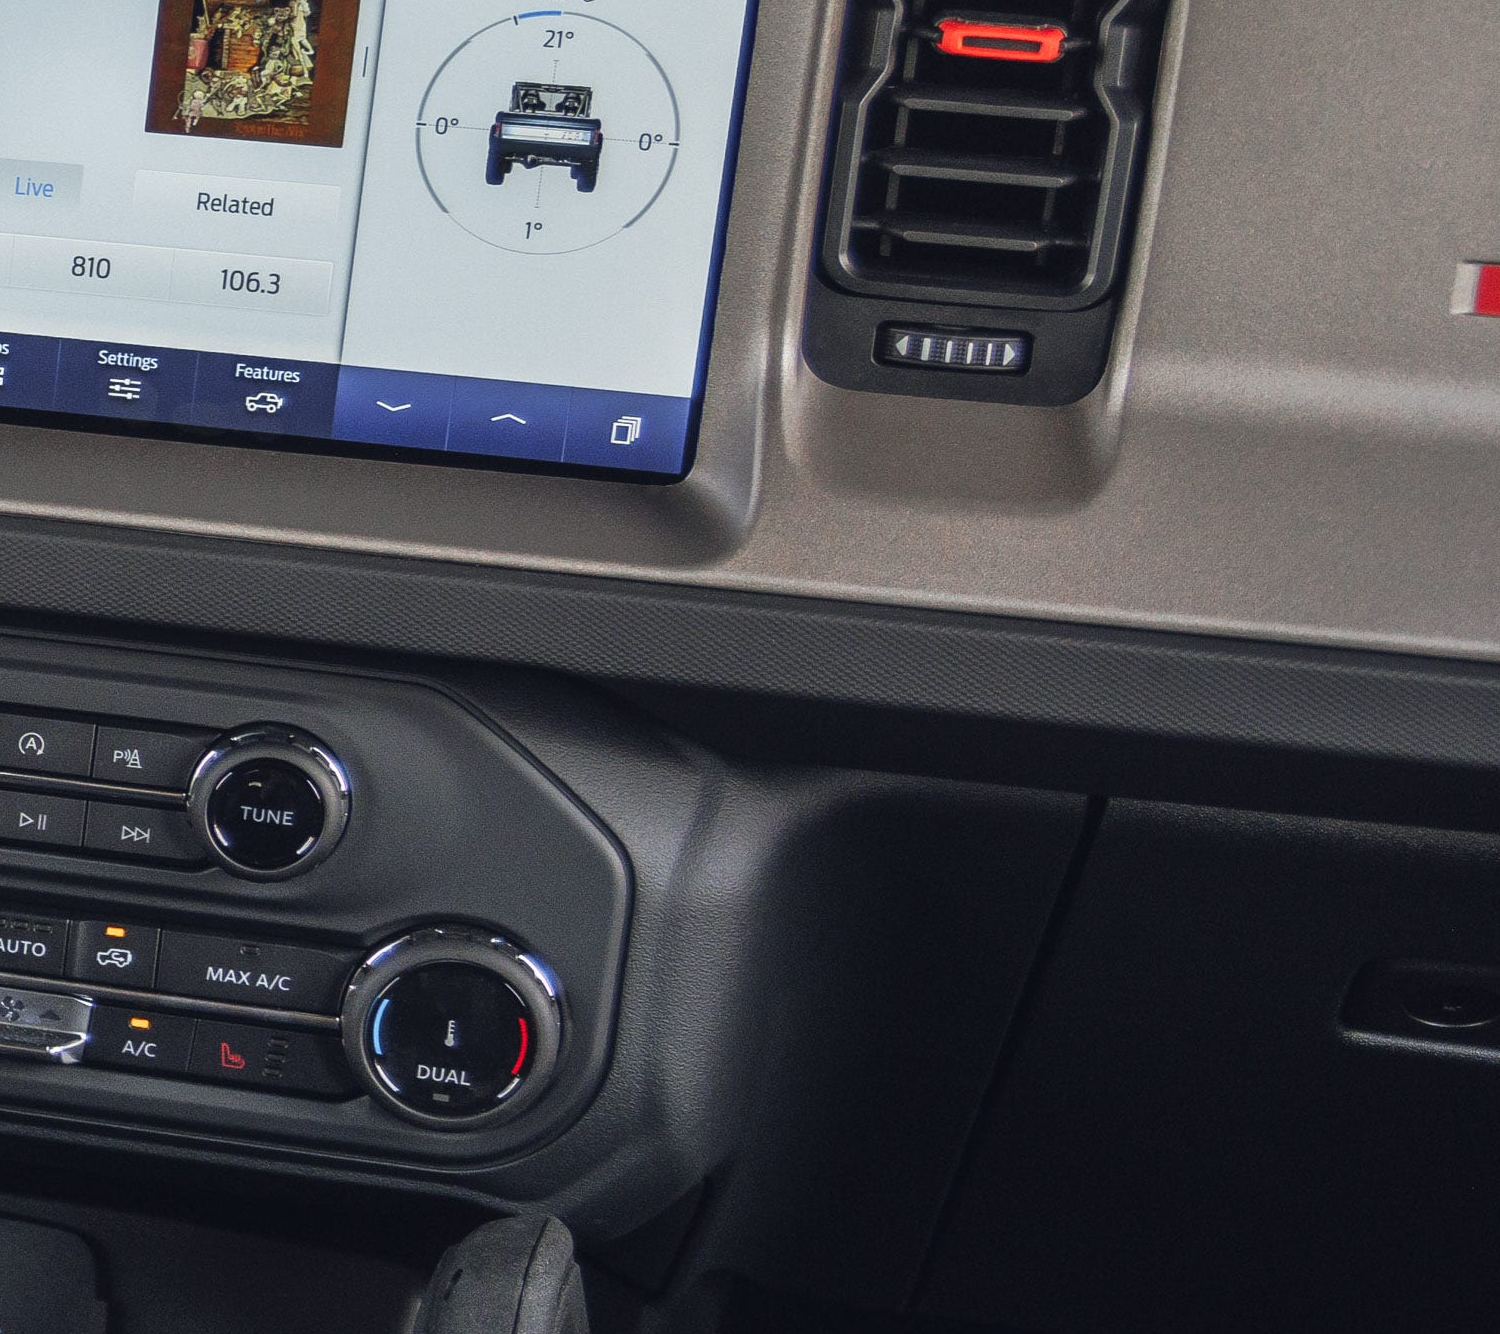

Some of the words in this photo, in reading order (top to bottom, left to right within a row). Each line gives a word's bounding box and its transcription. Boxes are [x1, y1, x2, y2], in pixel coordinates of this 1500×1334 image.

[542, 29, 576, 51] 21°
[14, 177, 54, 199] Live
[196, 191, 274, 218] Related
[70, 254, 112, 281] 810
[219, 268, 281, 296] 106.3
[98, 349, 159, 373] Settings
[235, 363, 301, 384] Features
[240, 805, 295, 826] TUNE
[206, 966, 250, 987] MAX
[255, 975, 291, 992] A/C
[121, 1040, 157, 1059] A/C
[416, 1064, 472, 1087] DUAL
